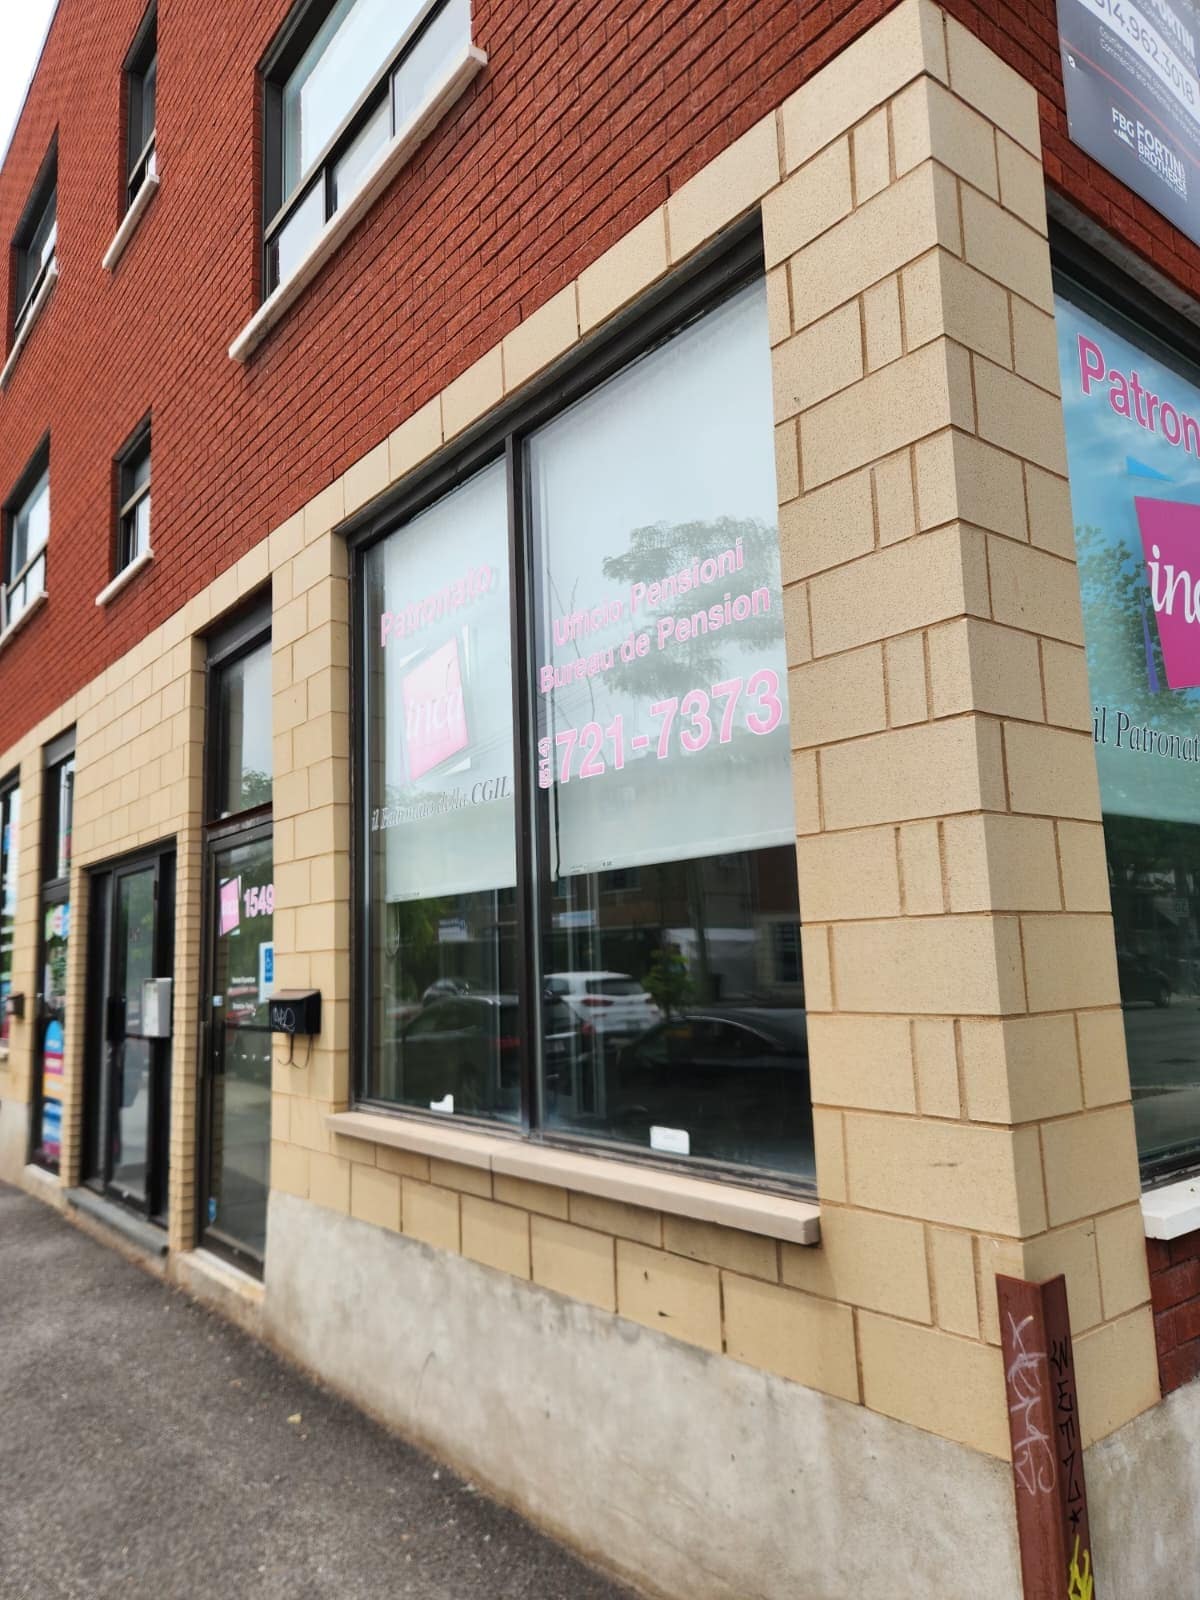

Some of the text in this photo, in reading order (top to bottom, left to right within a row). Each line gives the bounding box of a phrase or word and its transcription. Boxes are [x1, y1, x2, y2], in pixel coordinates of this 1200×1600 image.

[1112, 107, 1135, 138] FBG
[1136, 120, 1183, 177] FORTIN
[1077, 333, 1200, 458] Patron
[552, 537, 744, 647] Ufficio Pensioni
[539, 586, 770, 693] Bureau de Pension
[555, 669, 783, 784] 721-7373
[1093, 706, 1107, 745] il
[471, 776, 510, 804] CGIL
[244, 884, 275, 918] 1549
